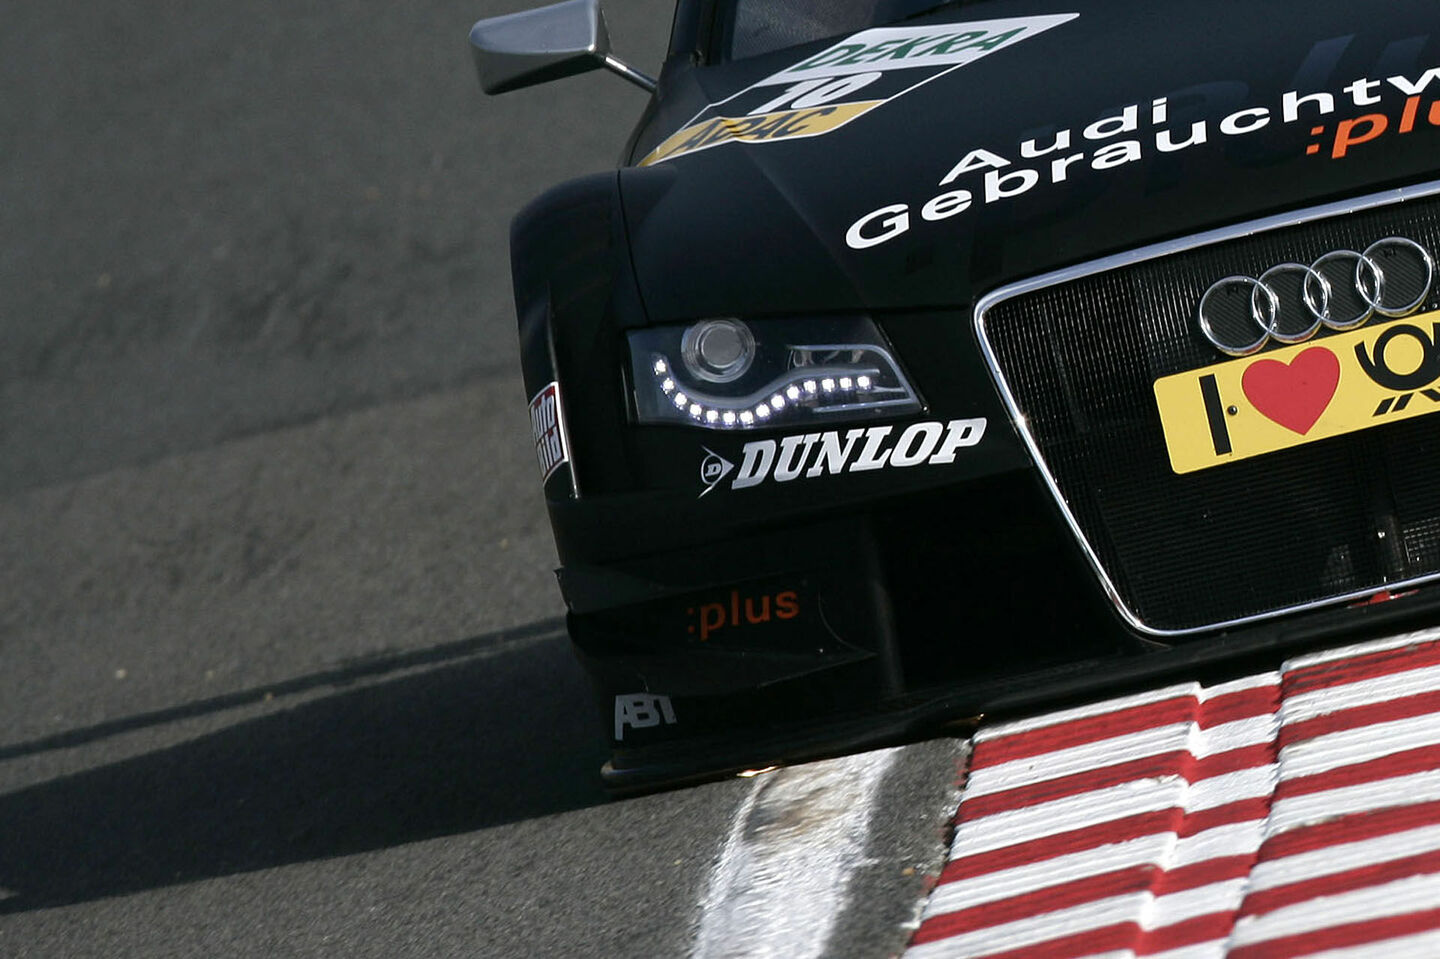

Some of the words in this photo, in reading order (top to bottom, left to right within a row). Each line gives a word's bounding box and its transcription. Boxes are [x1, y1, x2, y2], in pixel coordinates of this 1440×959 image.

[786, 26, 1026, 73] DEKRA
[747, 72, 882, 115] 10
[661, 106, 839, 159] ADAC
[939, 97, 1169, 186] Audi
[1199, 373, 1232, 456] I
[731, 418, 987, 489] DUNLOP
[687, 590, 800, 639] :plus
[615, 693, 677, 740] ABT
